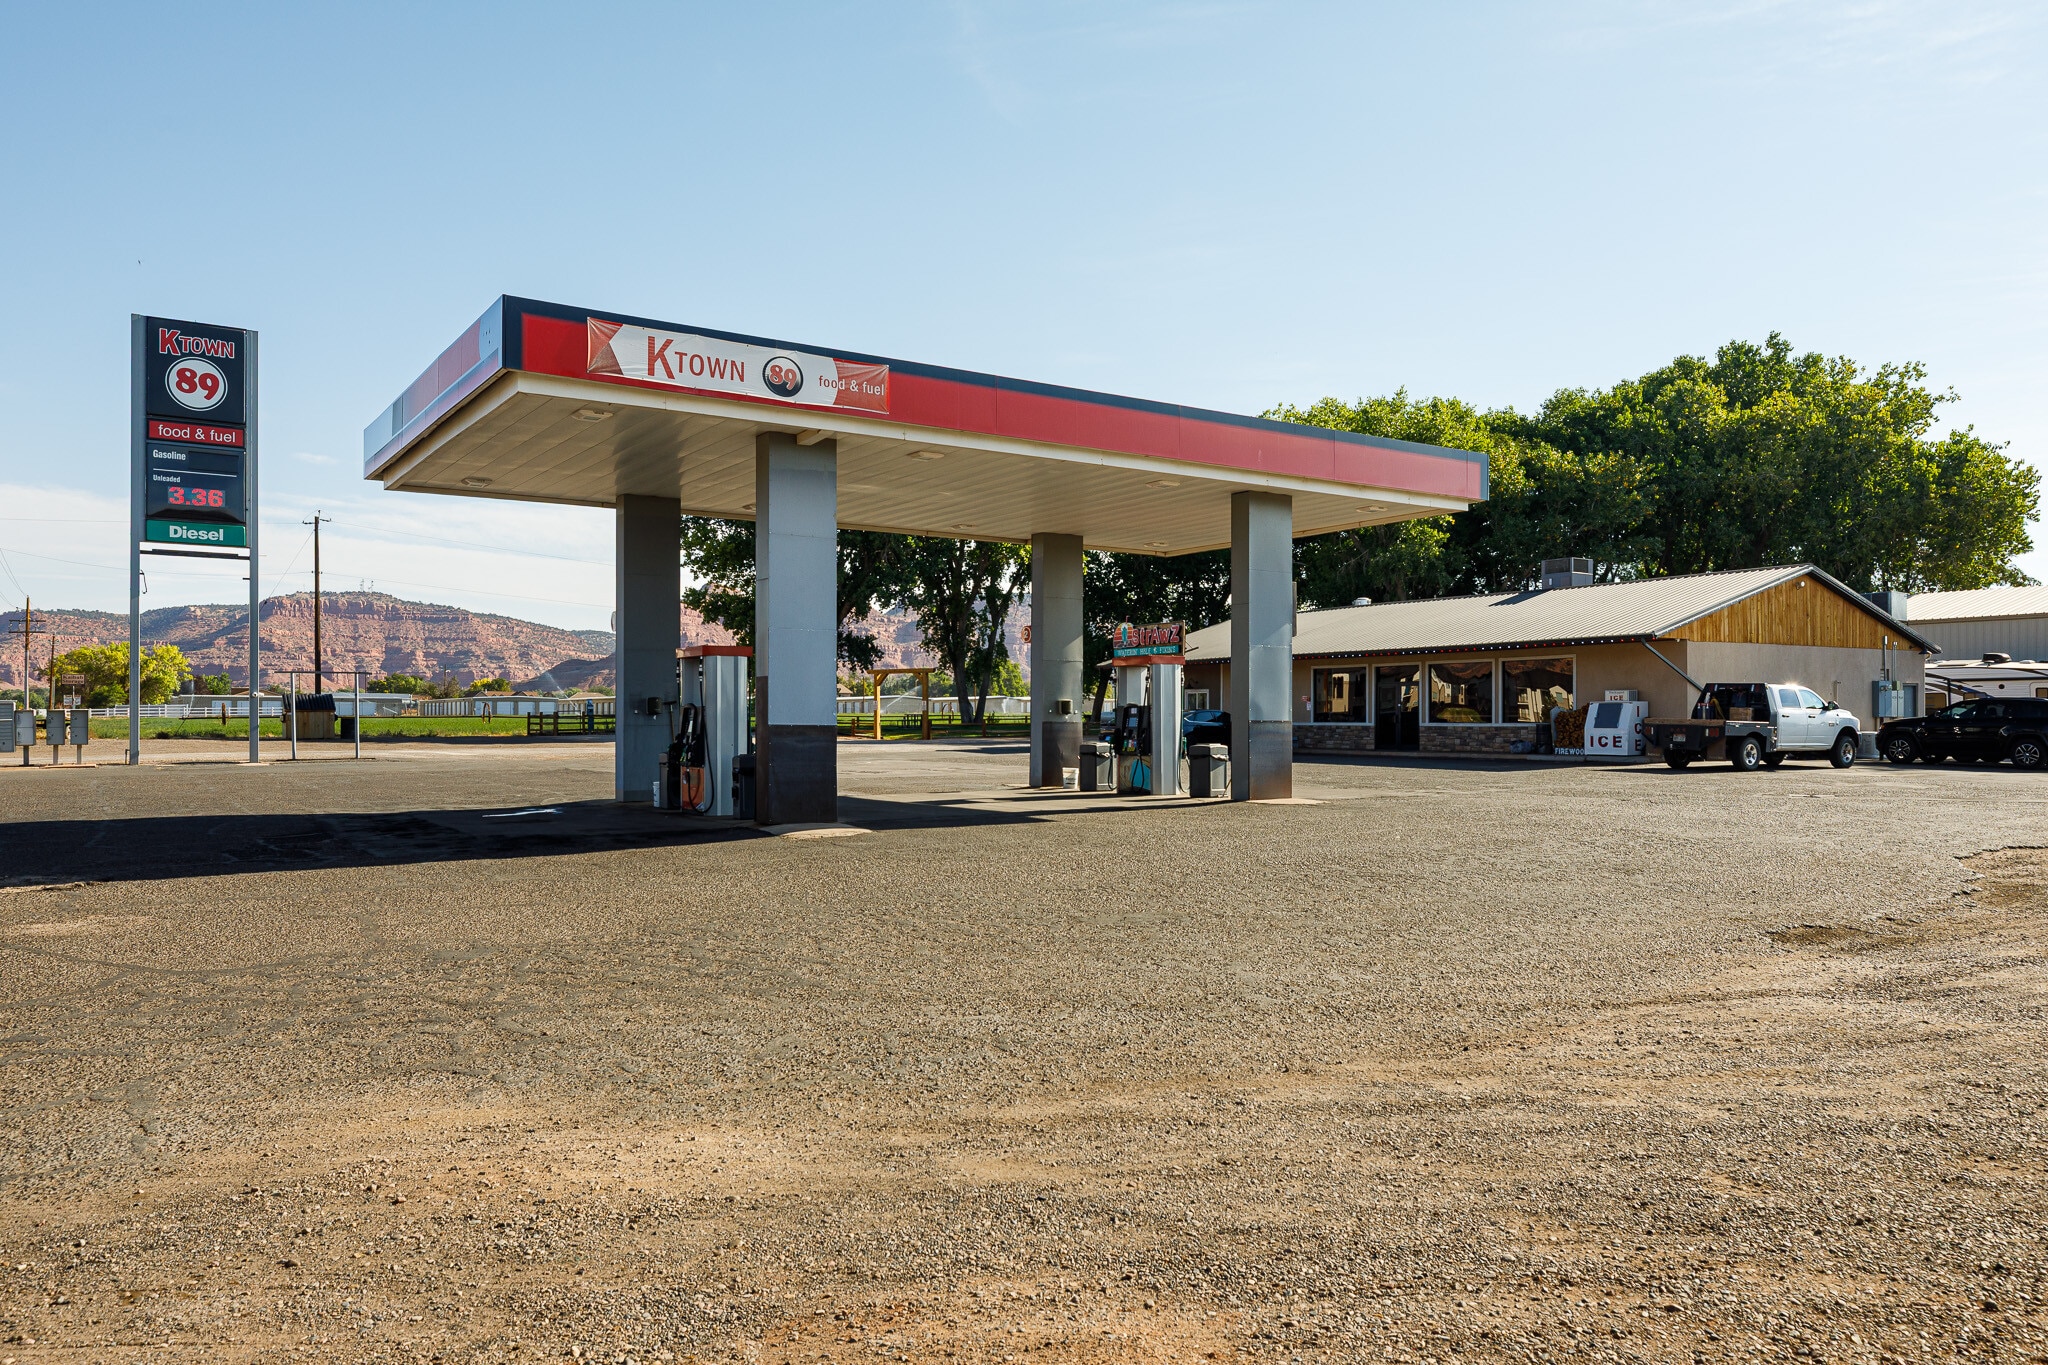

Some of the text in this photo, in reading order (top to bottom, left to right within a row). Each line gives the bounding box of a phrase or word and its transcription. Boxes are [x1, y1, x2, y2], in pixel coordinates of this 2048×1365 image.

[158, 328, 235, 359] KTOWN
[647, 335, 745, 383] KTOWN
[175, 367, 220, 401] 89
[769, 364, 797, 390] 89
[818, 375, 885, 396] food & fuel
[158, 424, 236, 443] food & fuel
[153, 449, 186, 461] Gasoline
[153, 474, 181, 483] Unleaded
[168, 486, 223, 508] 3.36
[169, 525, 224, 542] Diesel
[1554, 747, 1585, 755] FIREWOO
[1590, 735, 1622, 748] ICE
